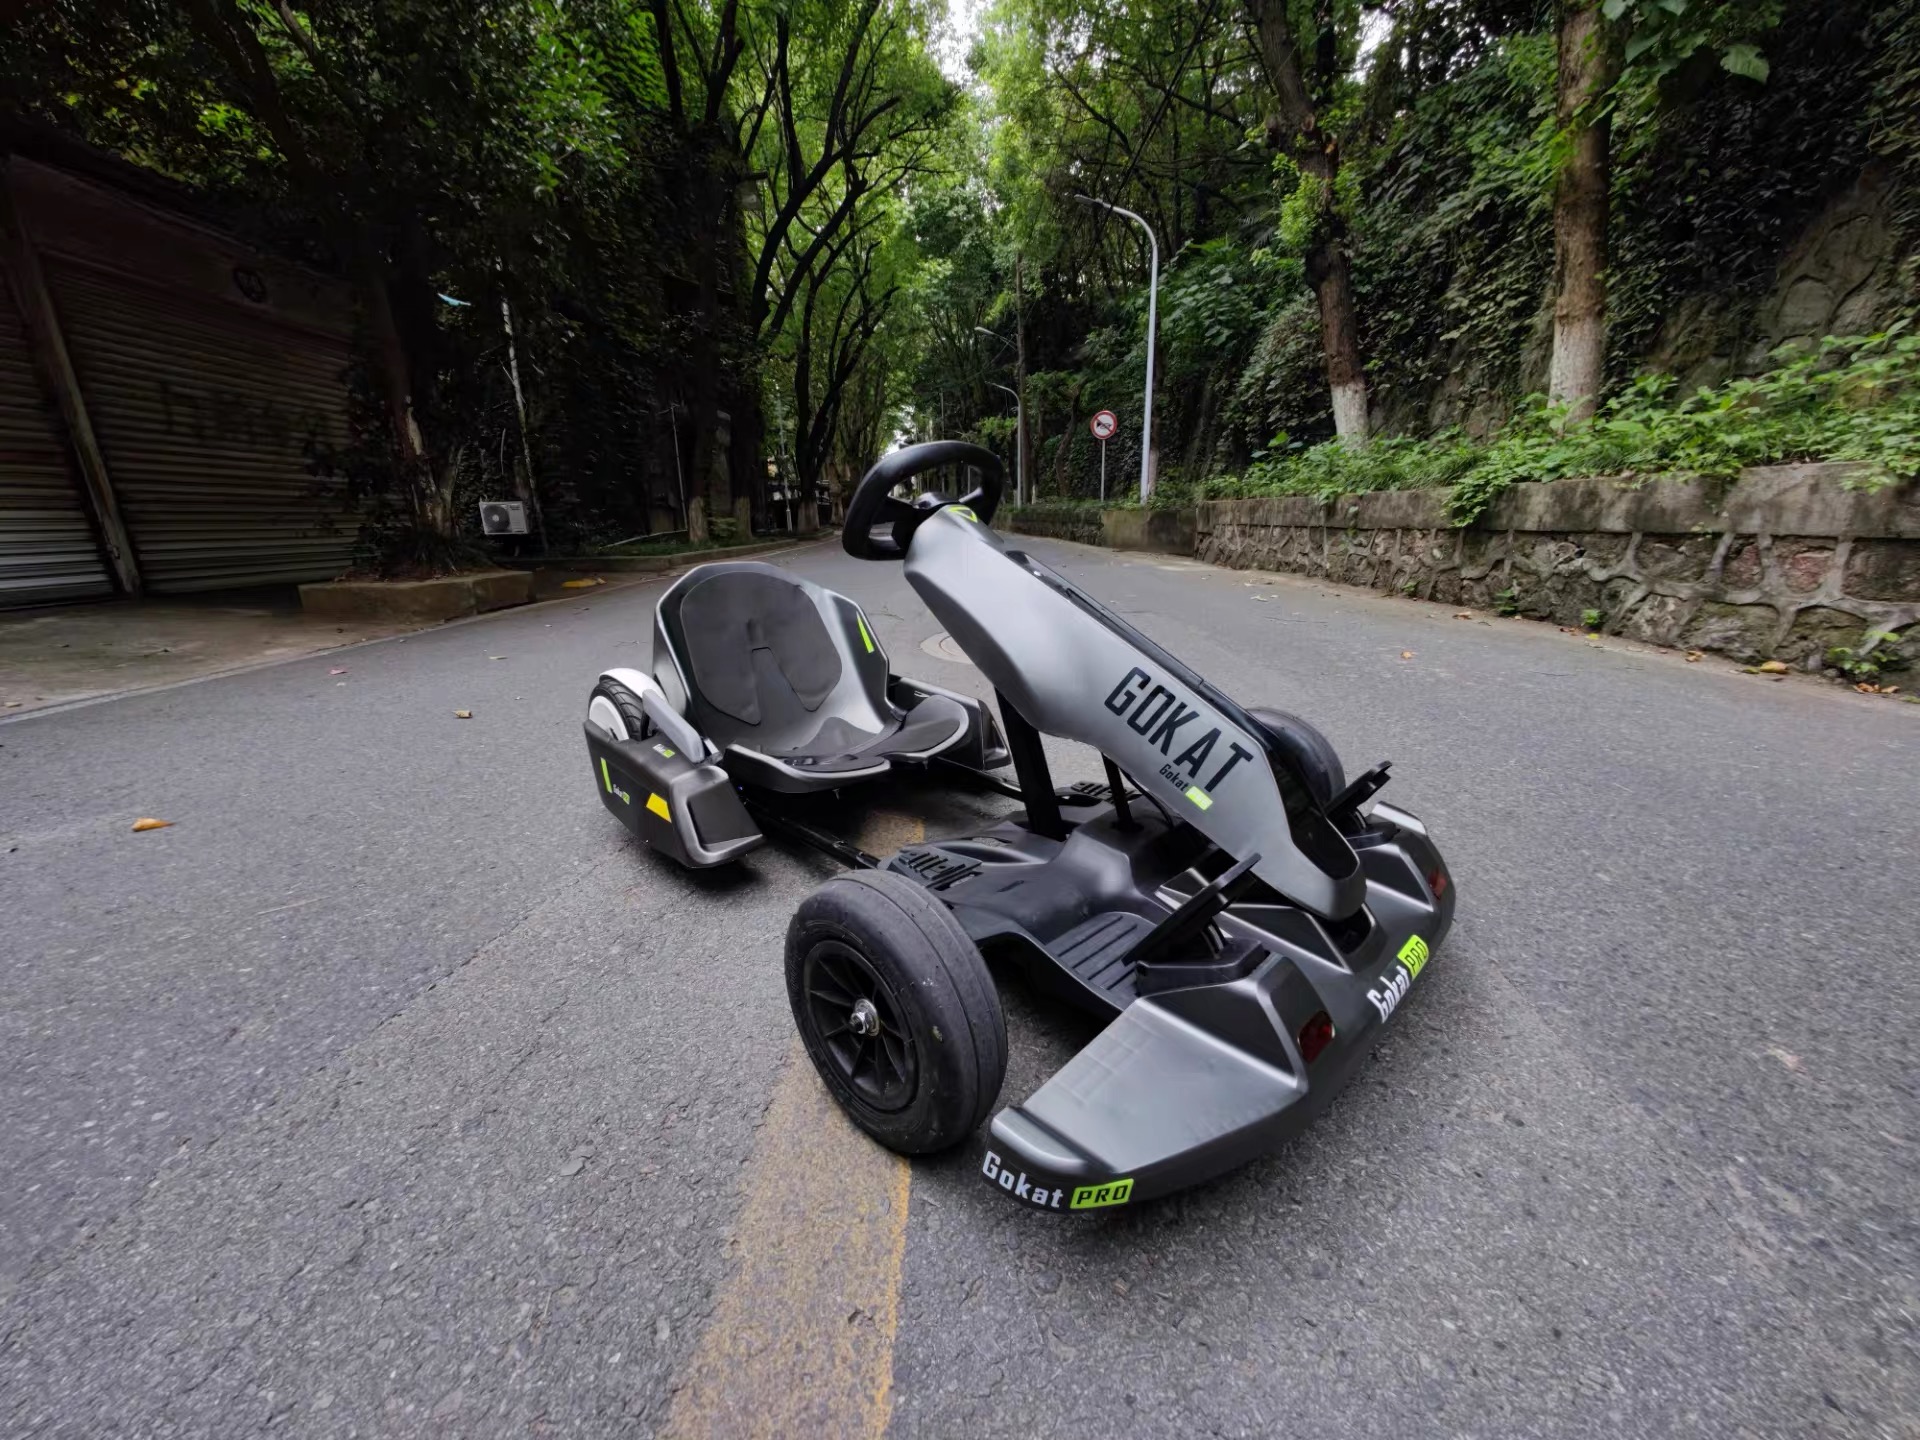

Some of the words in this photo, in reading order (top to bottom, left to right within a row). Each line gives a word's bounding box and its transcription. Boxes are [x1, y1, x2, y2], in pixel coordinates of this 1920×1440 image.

[1104, 666, 1254, 793] GOKAT
[1159, 763, 1189, 792] Gokat
[1366, 965, 1410, 1024] Gokat
[1404, 940, 1428, 975] PRO
[982, 1150, 1063, 1208] Gokat
[1076, 1184, 1129, 1205] PRO
